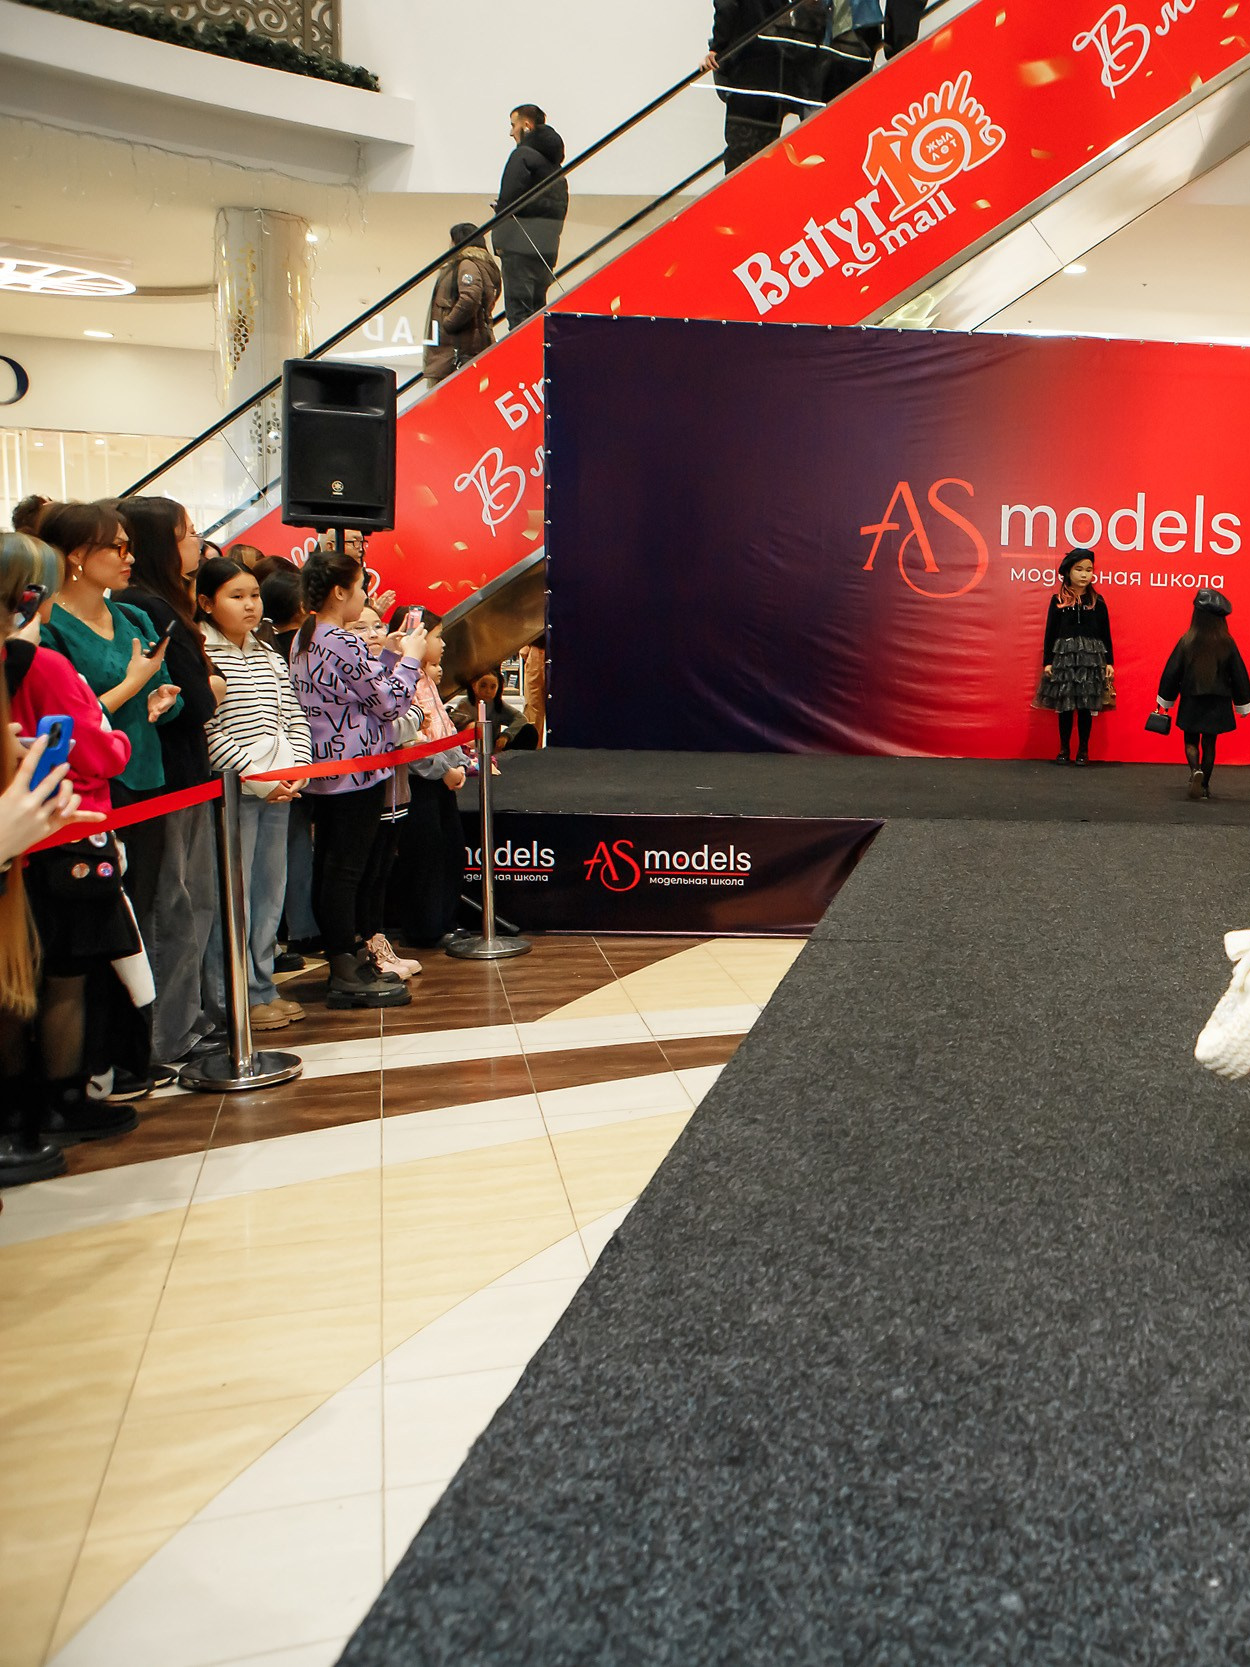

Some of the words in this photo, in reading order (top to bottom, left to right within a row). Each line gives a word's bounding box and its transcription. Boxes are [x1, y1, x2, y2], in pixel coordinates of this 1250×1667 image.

[879, 190, 956, 255] mall
[732, 188, 880, 315] Batyr
[860, 477, 989, 598] AS
[1000, 492, 1242, 555] models
[1150, 570, 1225, 589] школа
[464, 840, 555, 867] dels
[583, 839, 641, 892] AS
[644, 844, 752, 872] models
[514, 874, 548, 882] школа
[650, 876, 707, 887] модельная
[710, 877, 744, 886] школа
